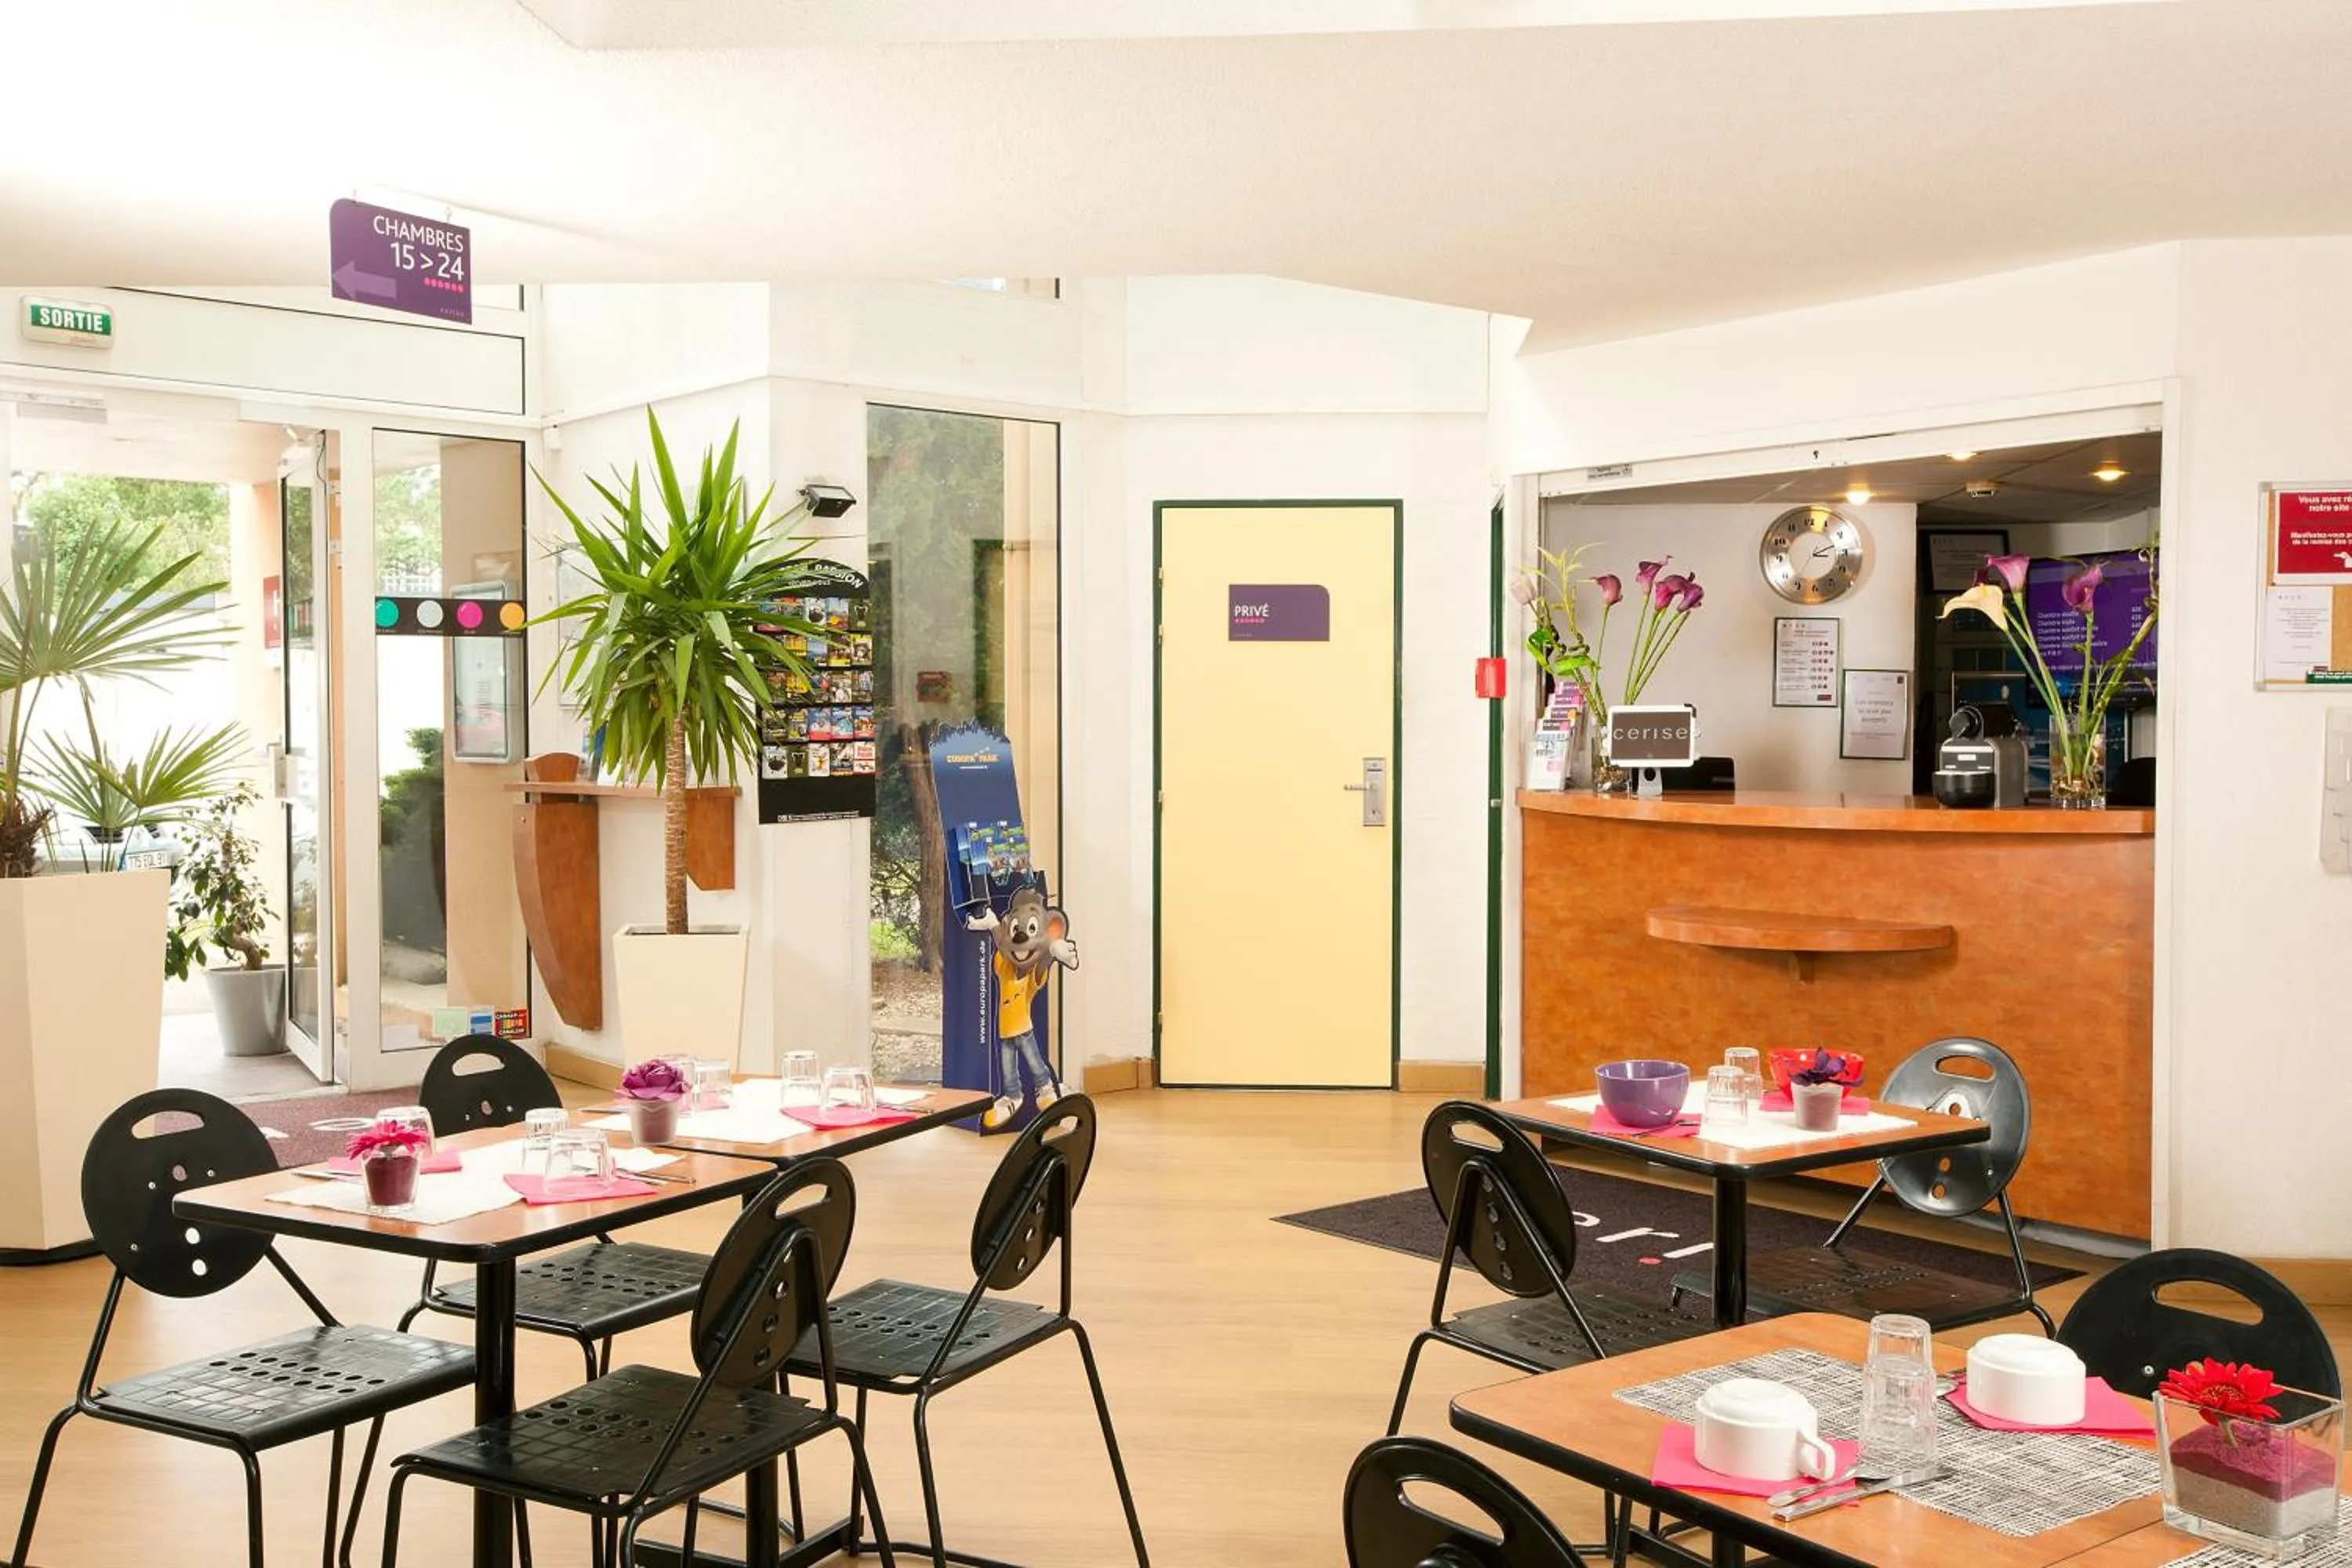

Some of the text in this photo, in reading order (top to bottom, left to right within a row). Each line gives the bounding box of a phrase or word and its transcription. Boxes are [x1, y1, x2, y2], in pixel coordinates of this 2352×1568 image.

[373, 216, 464, 252] CHAMBRES
[390, 242, 415, 270] 15
[437, 252, 464, 281] 24
[39, 307, 103, 332] SORTIE
[1235, 603, 1269, 617] PRIVÉ
[1613, 727, 1689, 740] cerise
[978, 940, 987, 1044] www.europapark.de
